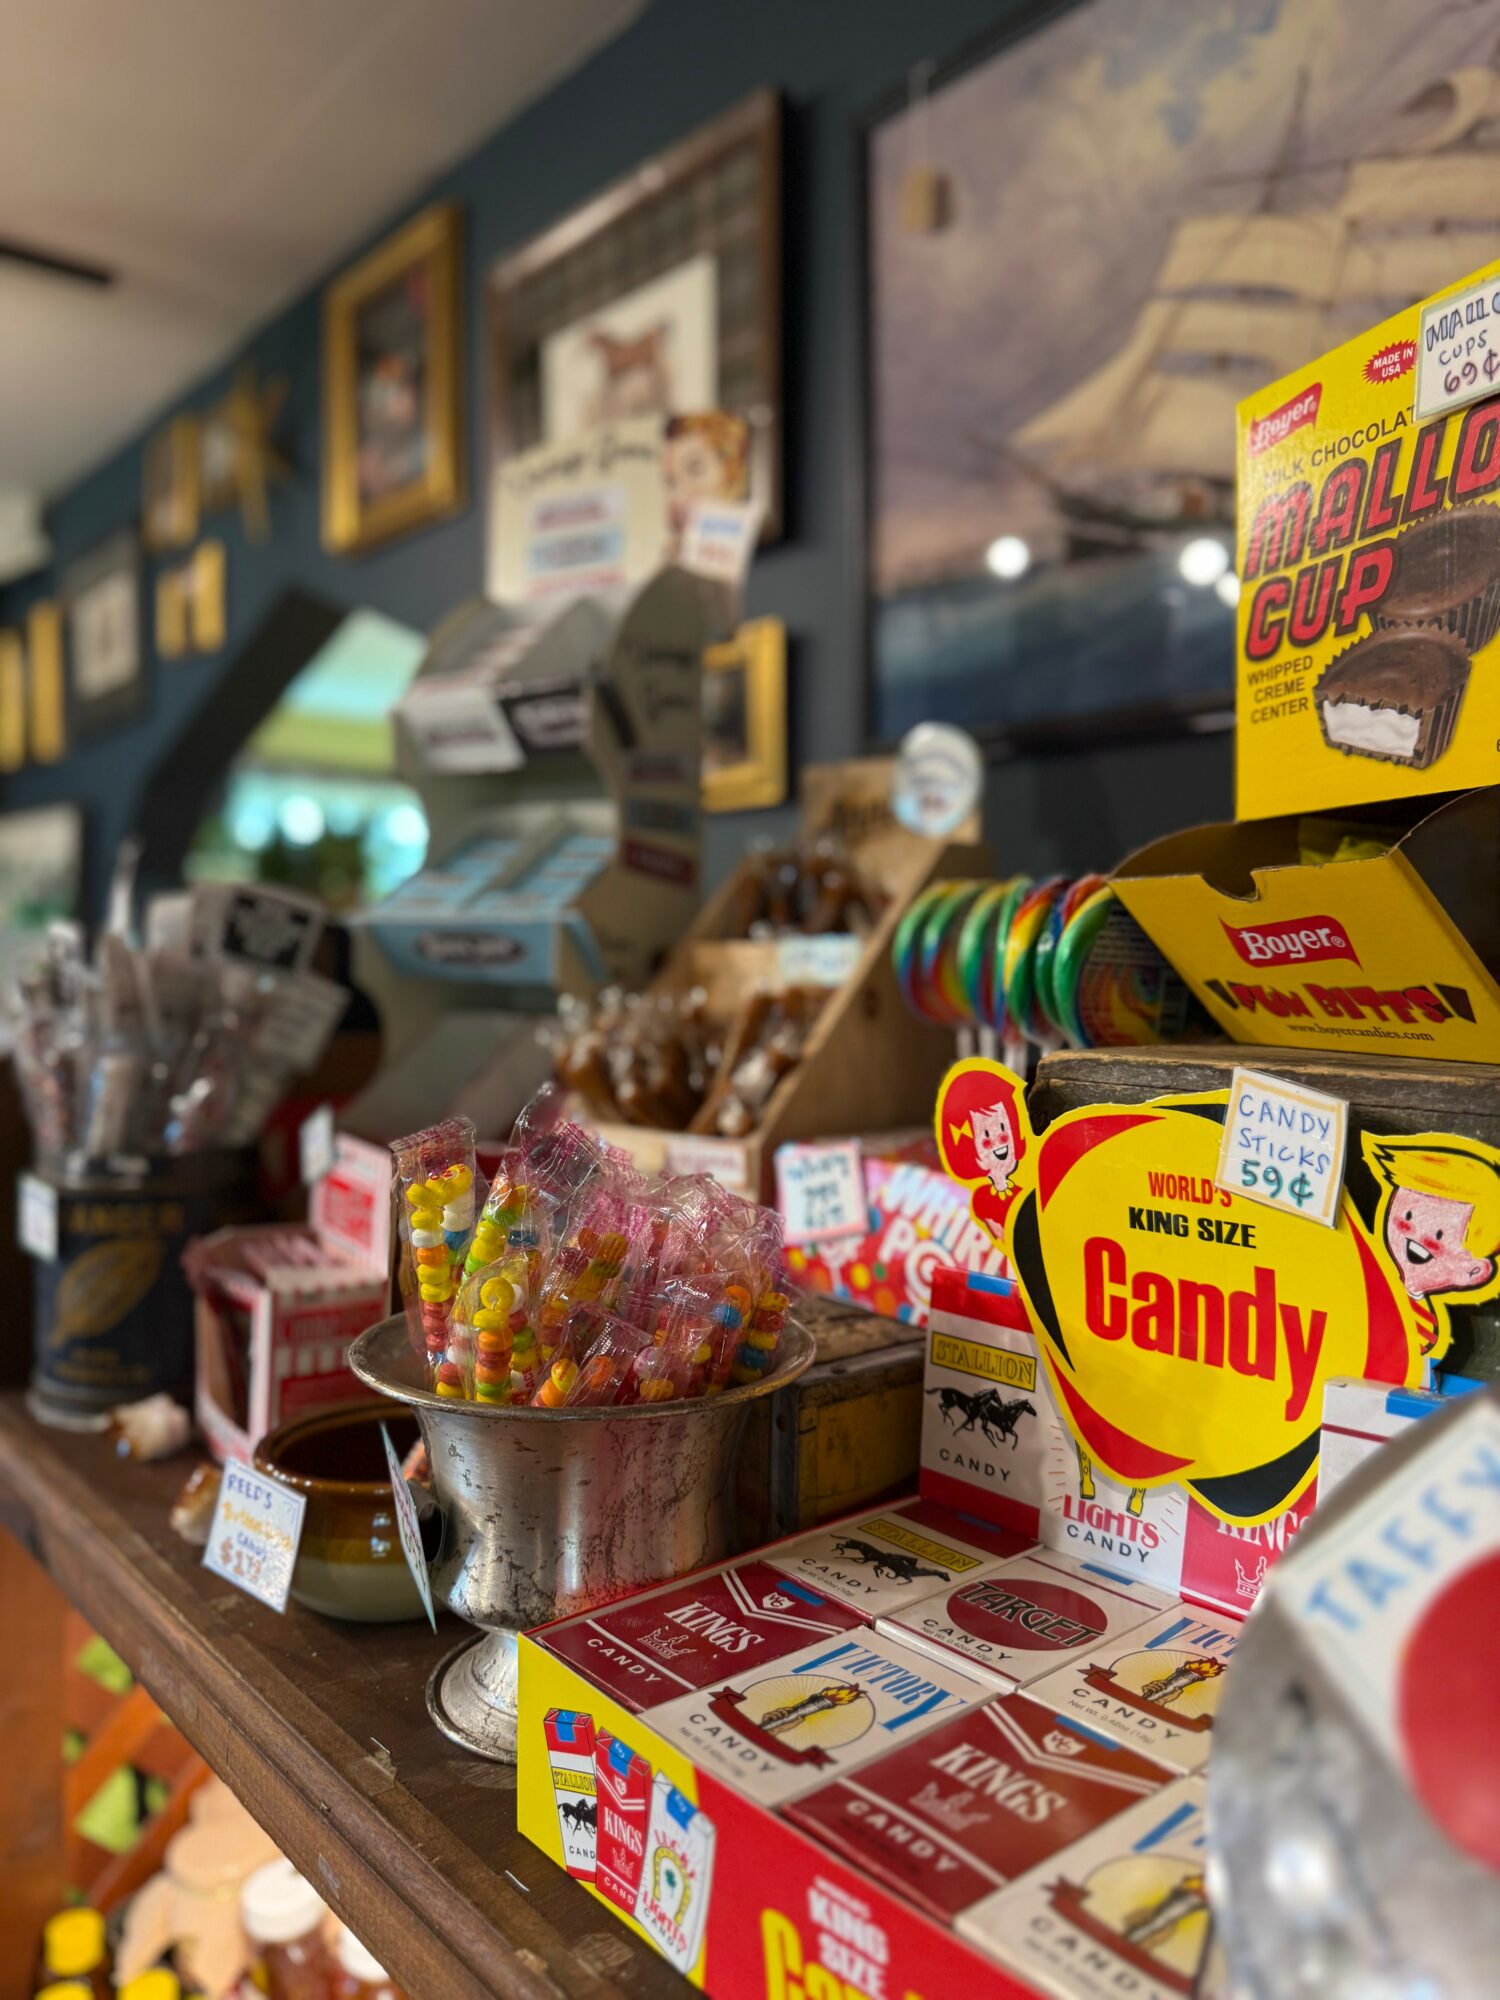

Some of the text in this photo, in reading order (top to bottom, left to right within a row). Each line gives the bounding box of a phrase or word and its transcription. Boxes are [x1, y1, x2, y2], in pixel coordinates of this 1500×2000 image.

[1373, 346, 1414, 370] MADE IN
[1439, 329, 1487, 365] CUPS
[1381, 363, 1401, 379] USA
[1444, 349, 1500, 395] 69¢
[1264, 458, 1304, 488] MILK
[1245, 538, 1397, 662] CUP
[1247, 656, 1313, 687] WHIPPED
[1254, 676, 1305, 704] CREME
[1251, 697, 1309, 725] CENTER
[1287, 1023, 1435, 1041] www.boyercandies.com
[1239, 1094, 1330, 1138] CANDY
[1239, 1127, 1331, 1175] STICKS
[1148, 1171, 1232, 1208] WORLD'S
[1241, 1159, 1314, 1208] 59¢
[1128, 1206, 1257, 1249] KING SIZE
[1084, 1236, 1328, 1422] Candy
[936, 1339, 1034, 1385] STALLION
[939, 1448, 1011, 1481] CANDY
[864, 1521, 972, 1568] STALLION
[1063, 1494, 1160, 1549] LIGHTS
[1067, 1524, 1150, 1563] CANDY
[802, 1558, 878, 1594] CANDY
[664, 1601, 765, 1653] KINGS
[957, 1580, 1106, 1648] TARGET
[586, 1638, 662, 1684] CANDY
[923, 1618, 1012, 1660] CANDY
[790, 1642, 969, 1733] VICTORY
[1072, 1688, 1181, 1739] CANDY
[689, 1714, 777, 1773] CANDY
[929, 1742, 1069, 1825] KINGS
[604, 1806, 643, 1857] KINGS
[846, 1799, 960, 1873] CANDY
[1030, 1915, 1159, 2000] CAND
